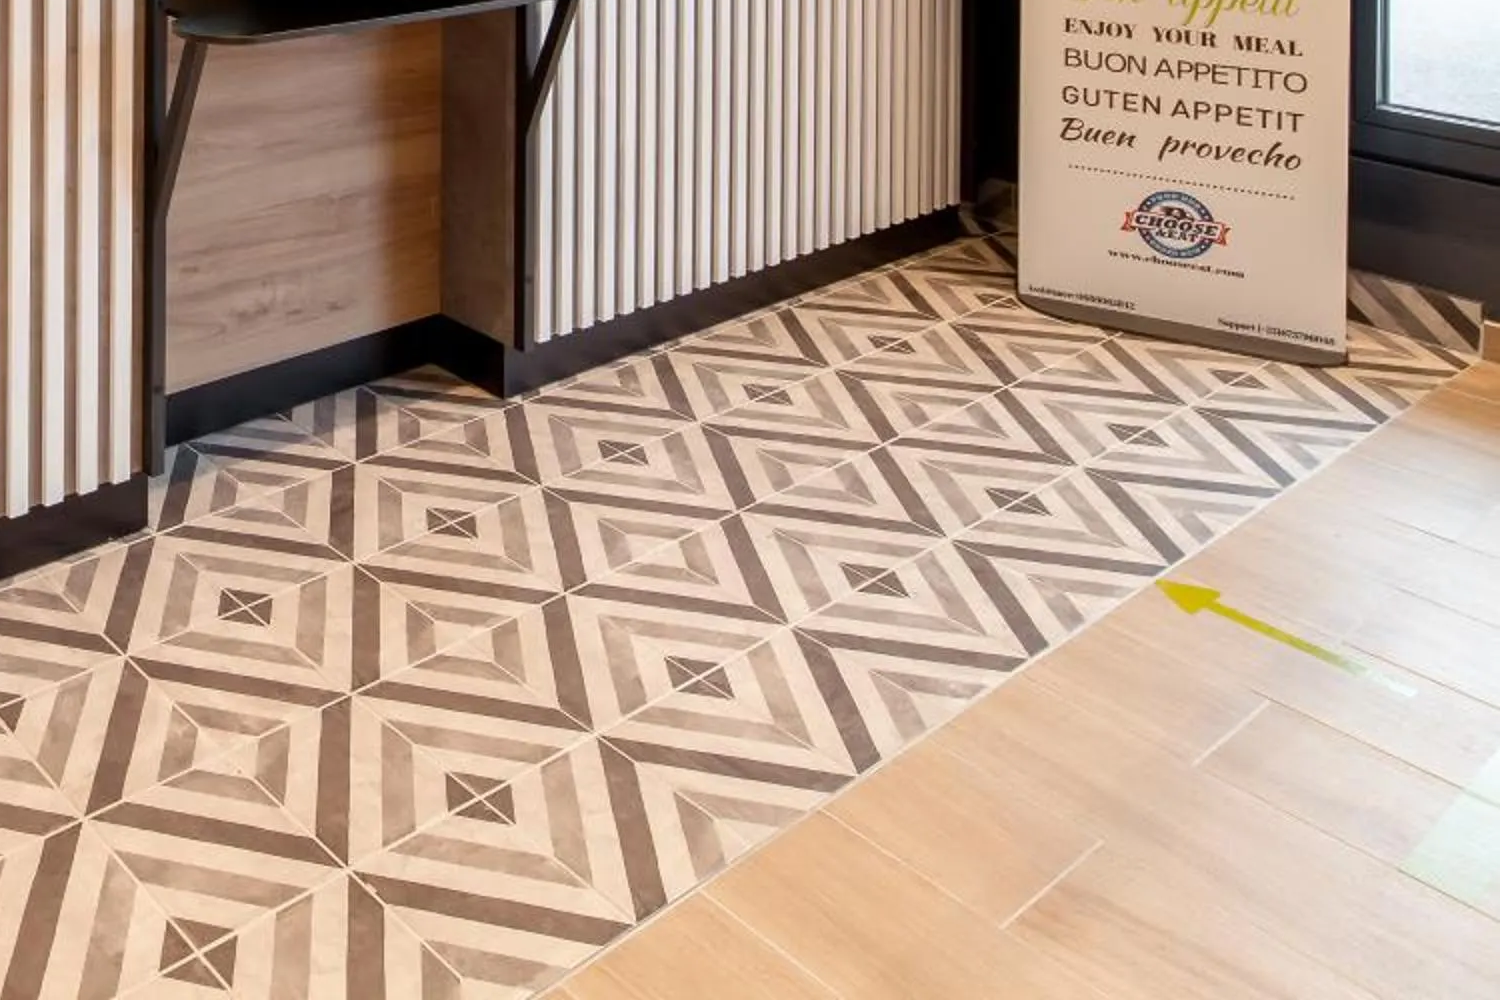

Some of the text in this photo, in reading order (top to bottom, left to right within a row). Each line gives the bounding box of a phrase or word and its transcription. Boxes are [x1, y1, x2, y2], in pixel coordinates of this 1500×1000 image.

[1063, 17, 1304, 57] ENJOY YOUR MEAL
[1063, 48, 1309, 95] BUON APPETITO
[1061, 85, 1305, 133] GUTEN APPETIT
[1059, 116, 1303, 171] Buen provecho
[1134, 213, 1220, 238] CHOOSE
